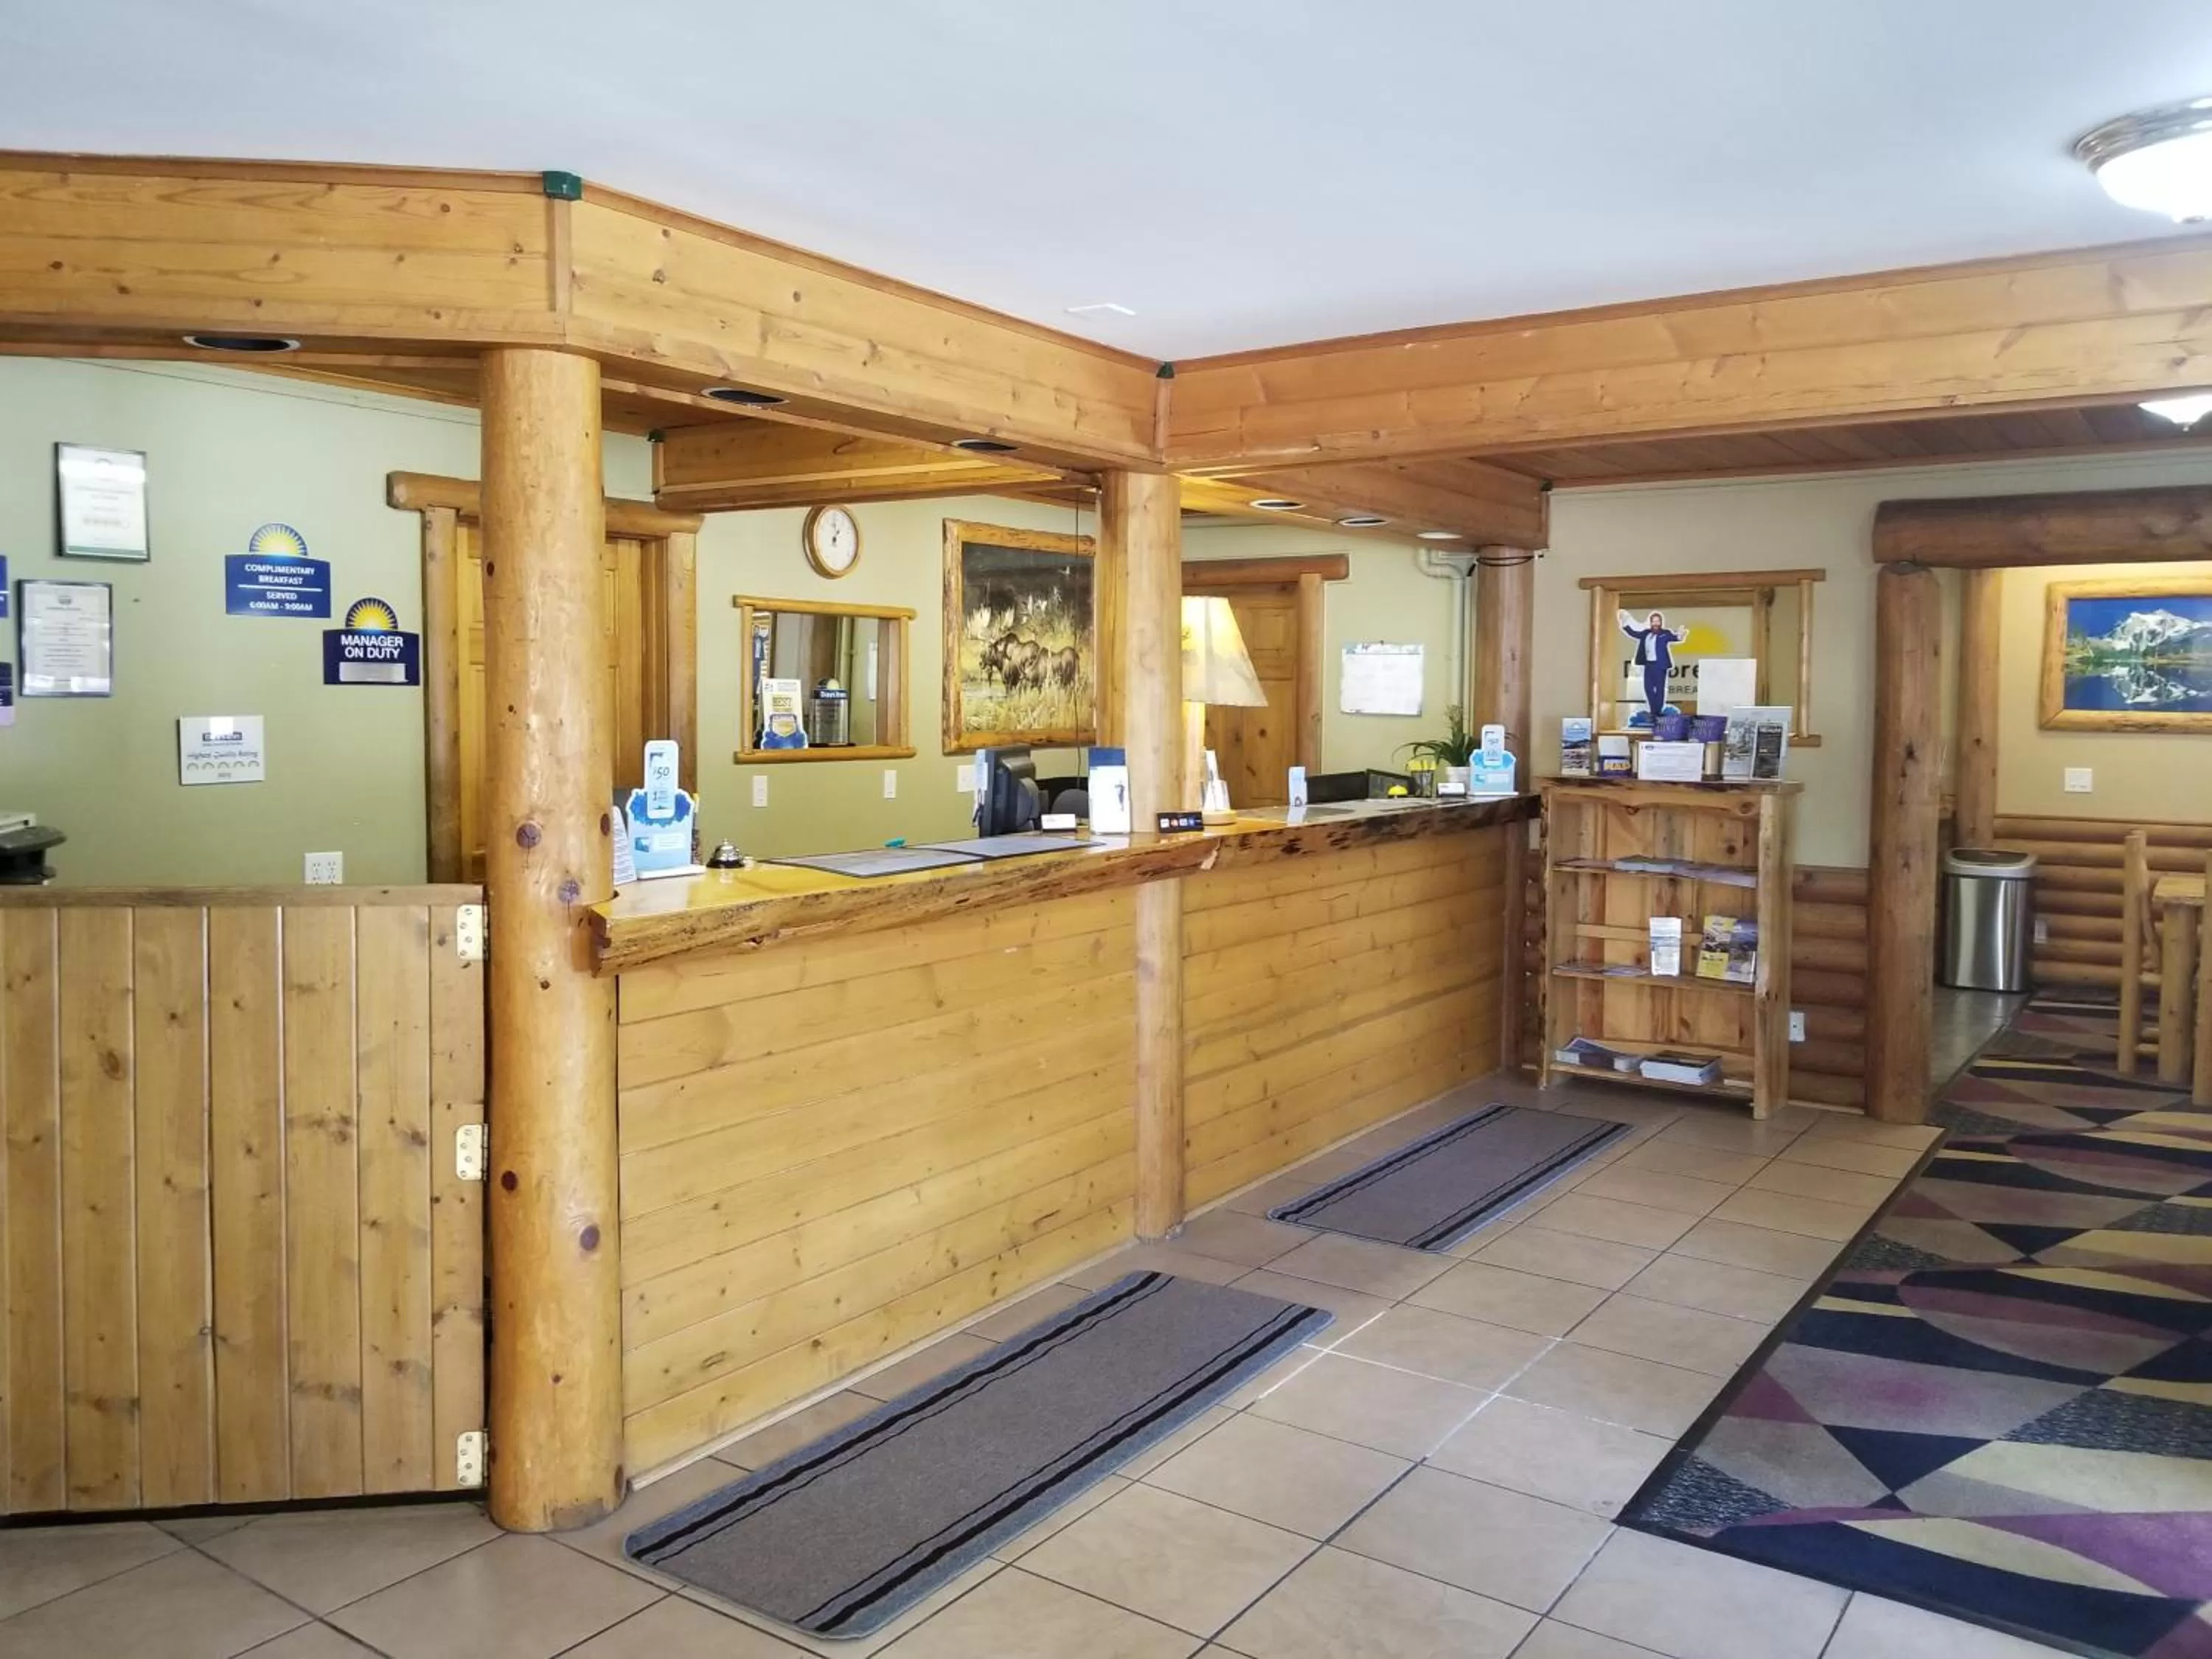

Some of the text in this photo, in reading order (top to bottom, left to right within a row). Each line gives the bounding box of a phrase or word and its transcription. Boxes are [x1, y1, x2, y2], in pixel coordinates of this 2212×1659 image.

[245, 563, 316, 575] COMPLIMENTARY
[258, 574, 304, 585] BREAKFAST
[266, 591, 297, 600] SERVED
[341, 634, 404, 647] MANAGER
[344, 647, 400, 659] ON DUTY
